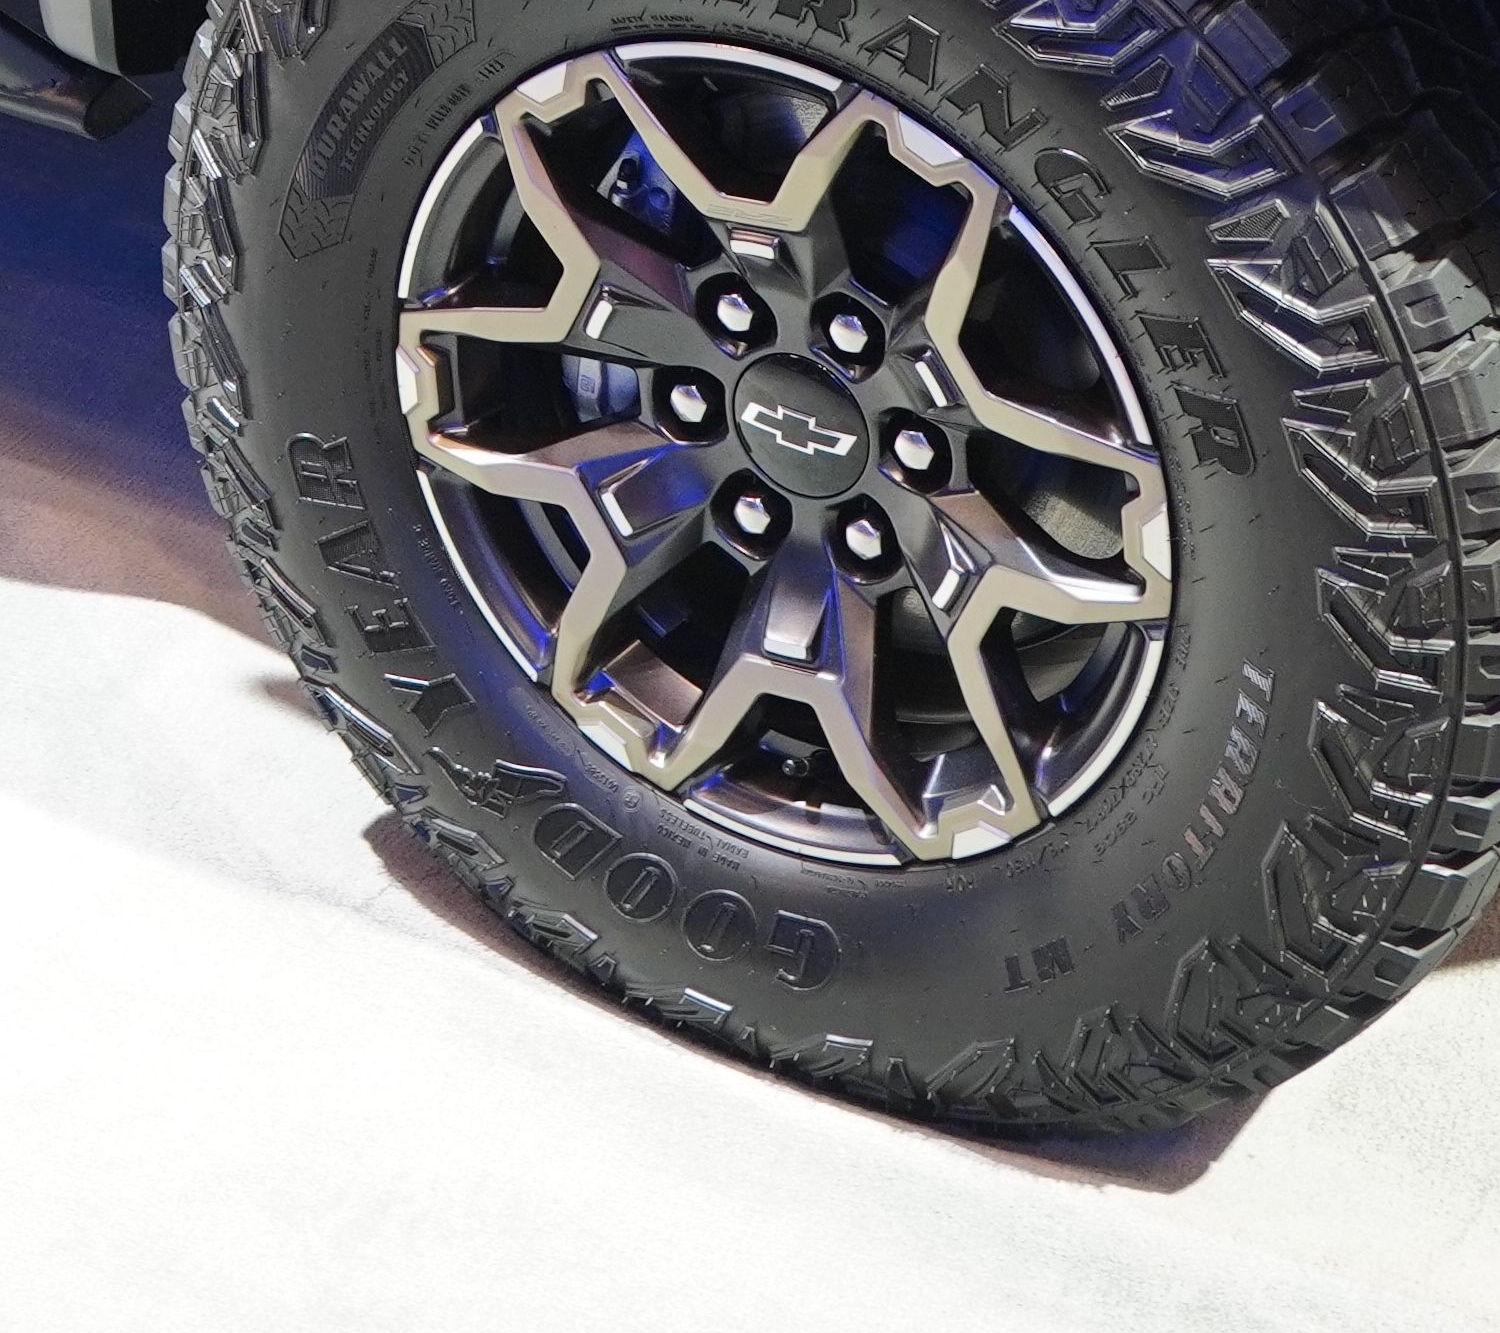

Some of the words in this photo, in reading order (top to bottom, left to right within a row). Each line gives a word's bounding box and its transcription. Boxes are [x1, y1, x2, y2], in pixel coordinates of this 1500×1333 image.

[309, 36, 408, 179] DURAWALL
[340, 69, 409, 171] TECHNOLOGY
[1110, 660, 1276, 944] TERRITORY
[1003, 937, 1076, 993] MT
